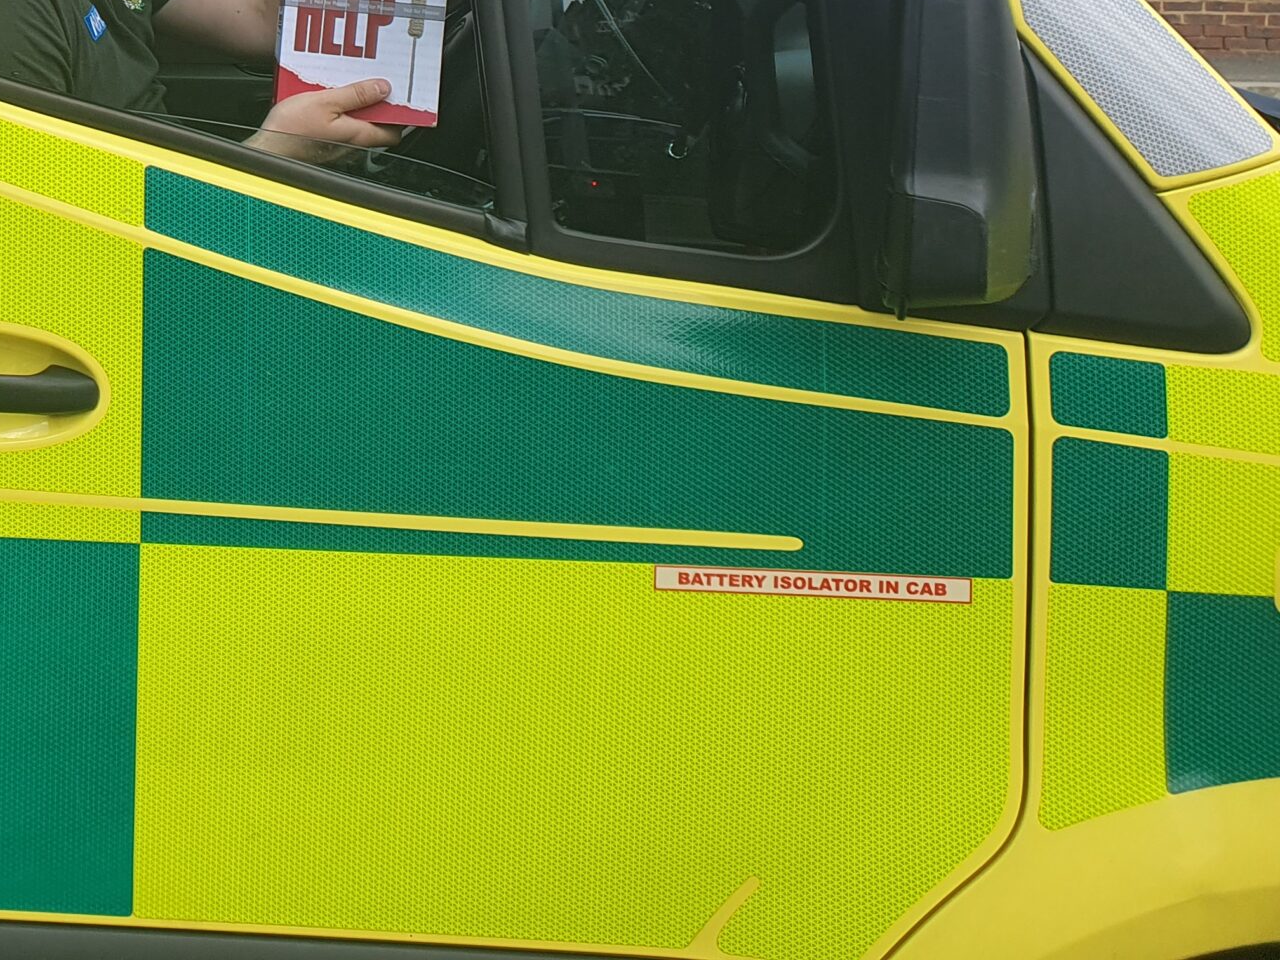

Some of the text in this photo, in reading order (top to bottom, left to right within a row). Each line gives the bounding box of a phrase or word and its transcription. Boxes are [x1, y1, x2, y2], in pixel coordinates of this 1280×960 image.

[678, 572, 947, 596] BATTERY ISOLATOR IN CAB
